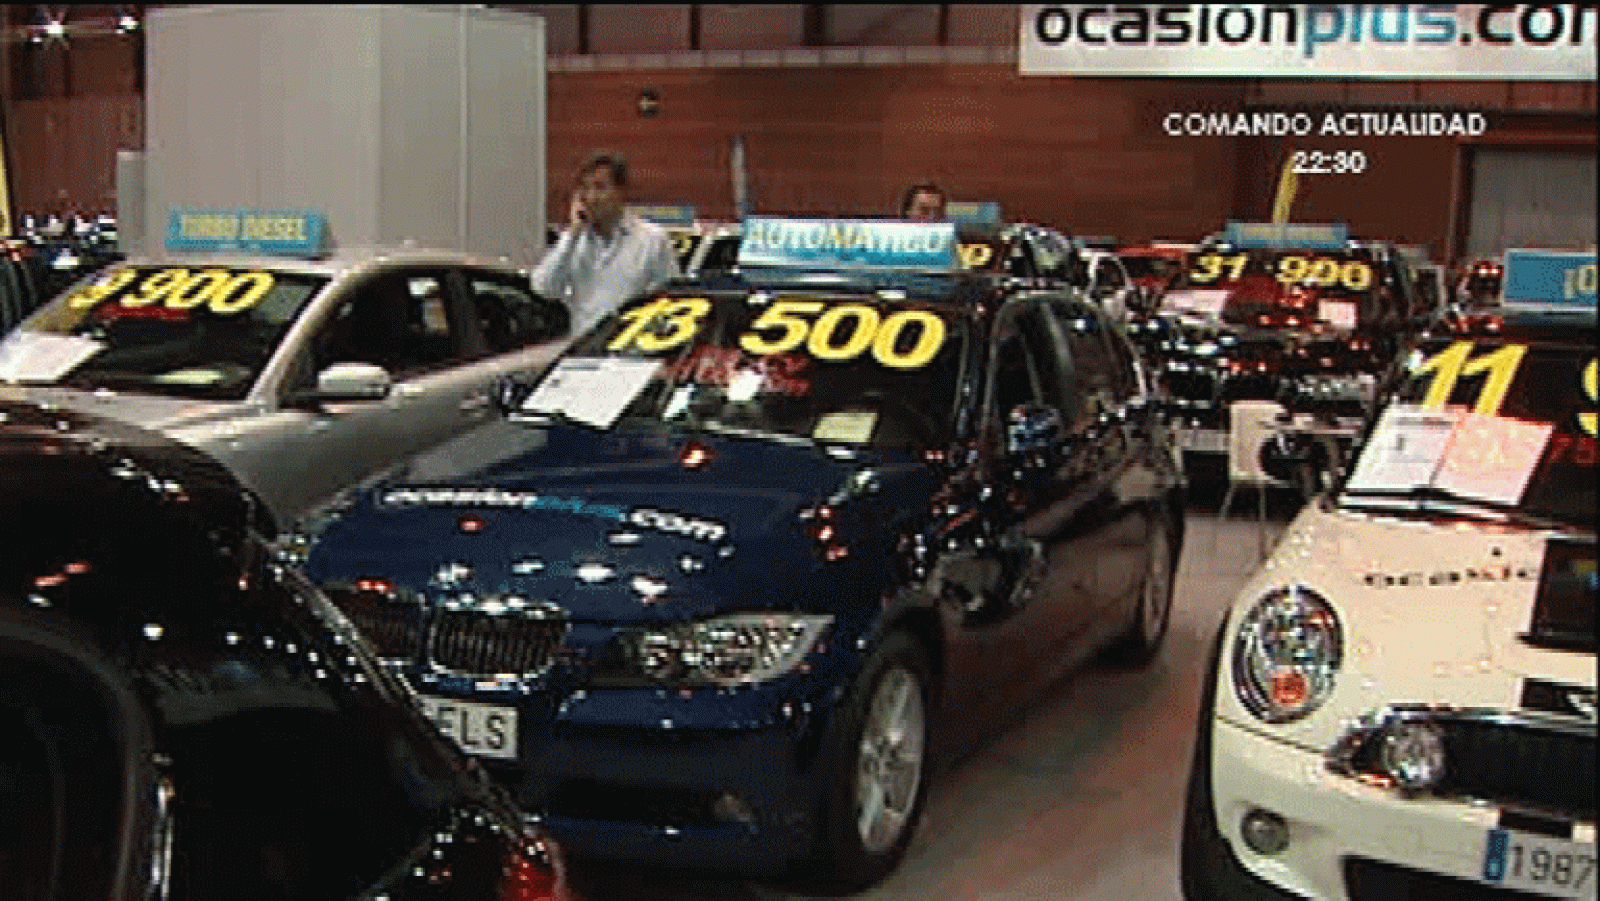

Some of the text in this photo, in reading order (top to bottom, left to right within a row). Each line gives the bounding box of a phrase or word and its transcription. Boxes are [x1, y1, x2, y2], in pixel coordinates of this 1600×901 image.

[119, 267, 276, 315] 900
[1189, 252, 1250, 284] 31
[1275, 255, 1373, 291] 900
[608, 296, 947, 369] 13 500
[1409, 339, 1529, 416] 11
[1511, 842, 1597, 890] 1987
